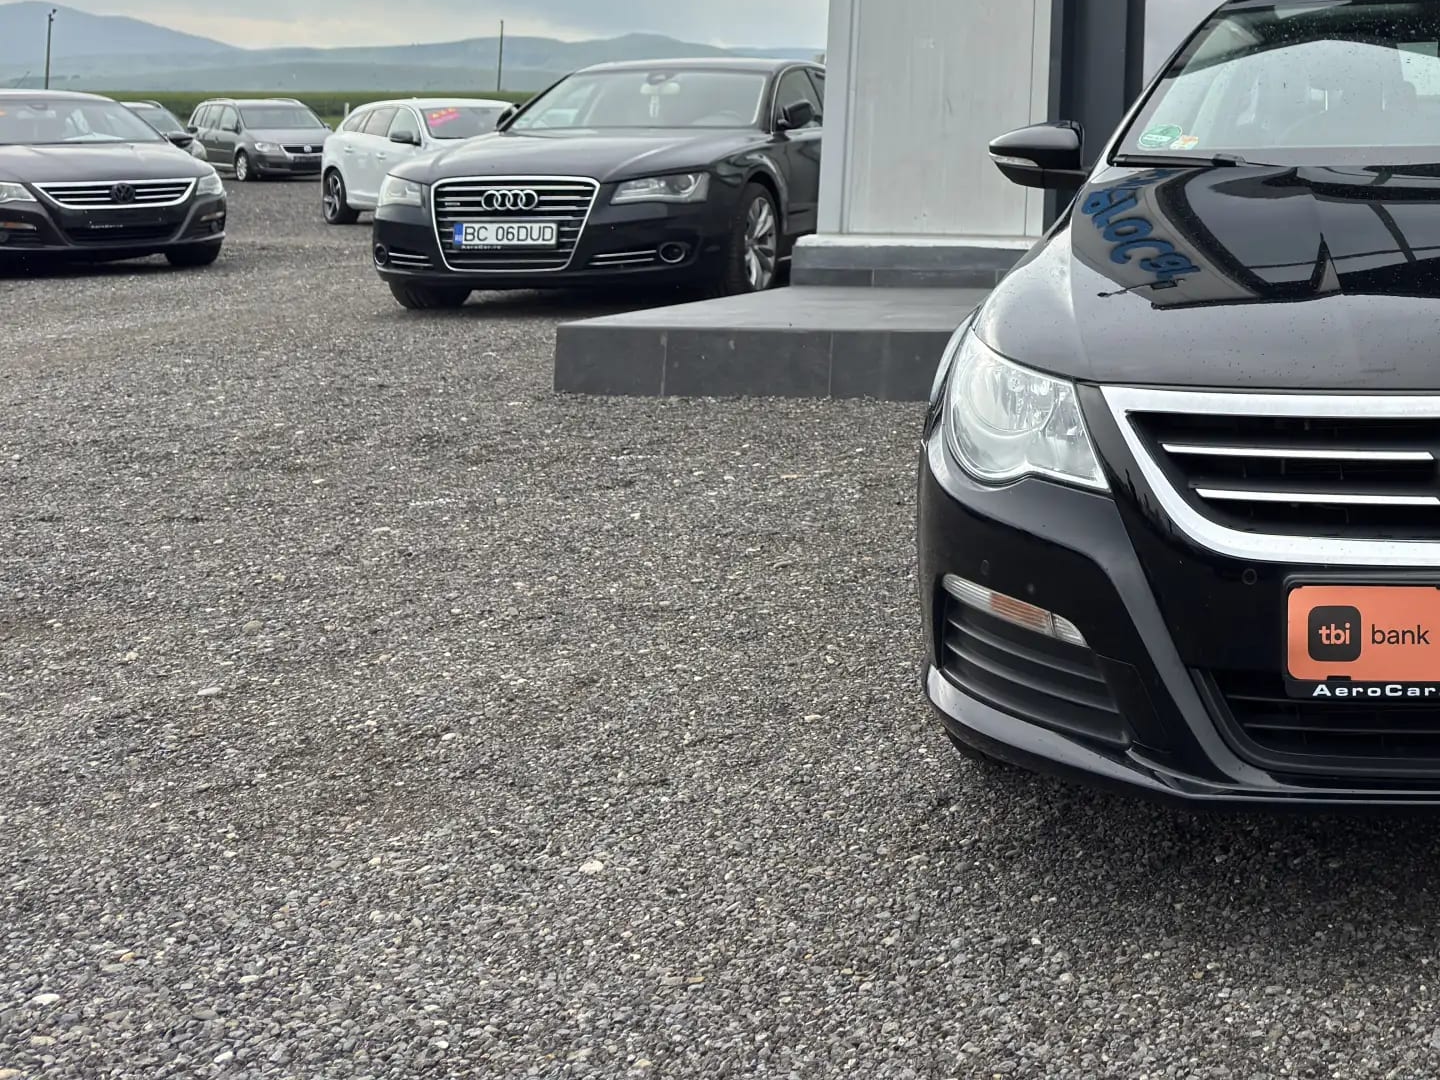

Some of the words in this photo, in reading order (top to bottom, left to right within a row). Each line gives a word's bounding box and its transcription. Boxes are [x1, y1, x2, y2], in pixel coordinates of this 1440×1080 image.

[464, 225, 488, 241] BC
[495, 225, 554, 241] 06DUD
[1318, 622, 1351, 645] tbi
[1371, 624, 1431, 645] bank
